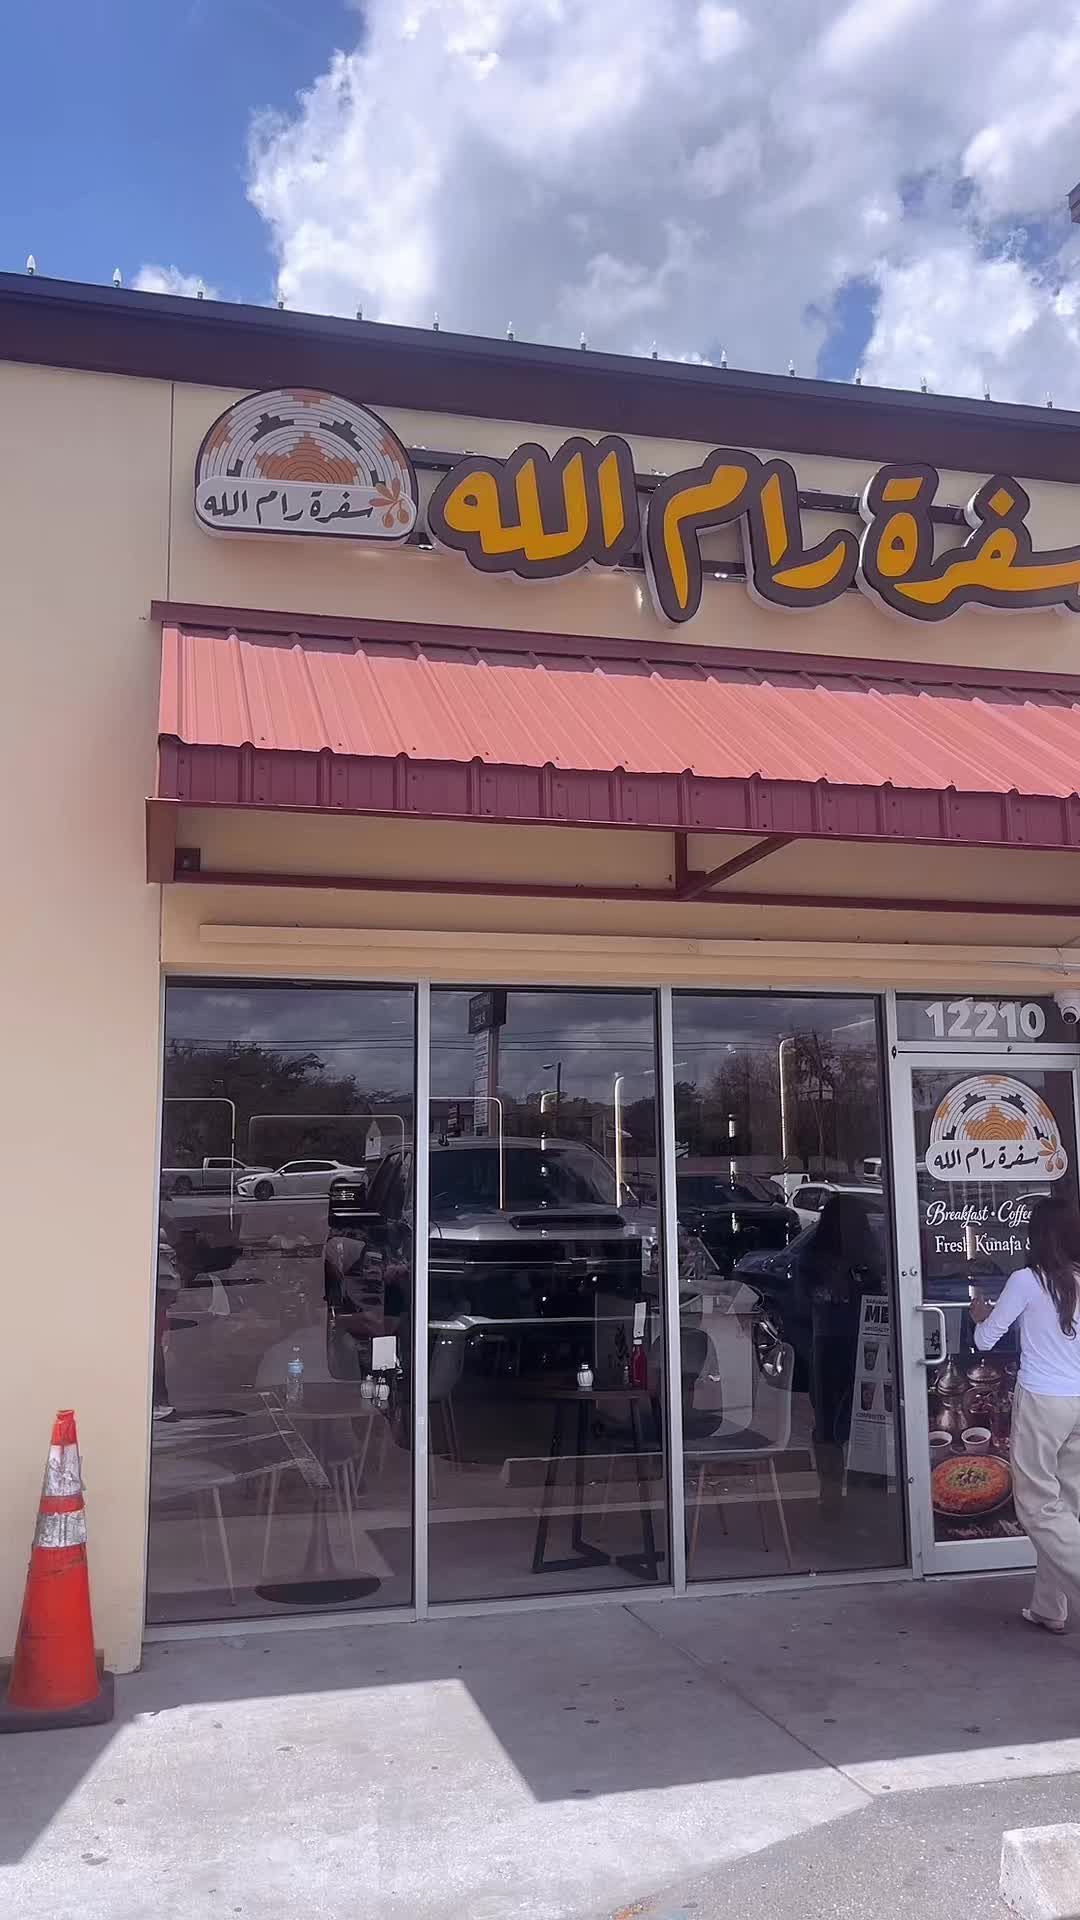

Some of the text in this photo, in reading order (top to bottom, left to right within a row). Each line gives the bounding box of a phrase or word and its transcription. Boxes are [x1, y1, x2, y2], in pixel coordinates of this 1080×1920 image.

[203, 489, 374, 525] سفرة رام الله
[442, 449, 626, 562] الله
[663, 464, 847, 609] رام
[925, 1001, 1046, 1039] 12210
[933, 1144, 1039, 1175] سفرة رام الله
[926, 1200, 988, 1229] Breakfast
[975, 1232, 1022, 1256] Kunafa
